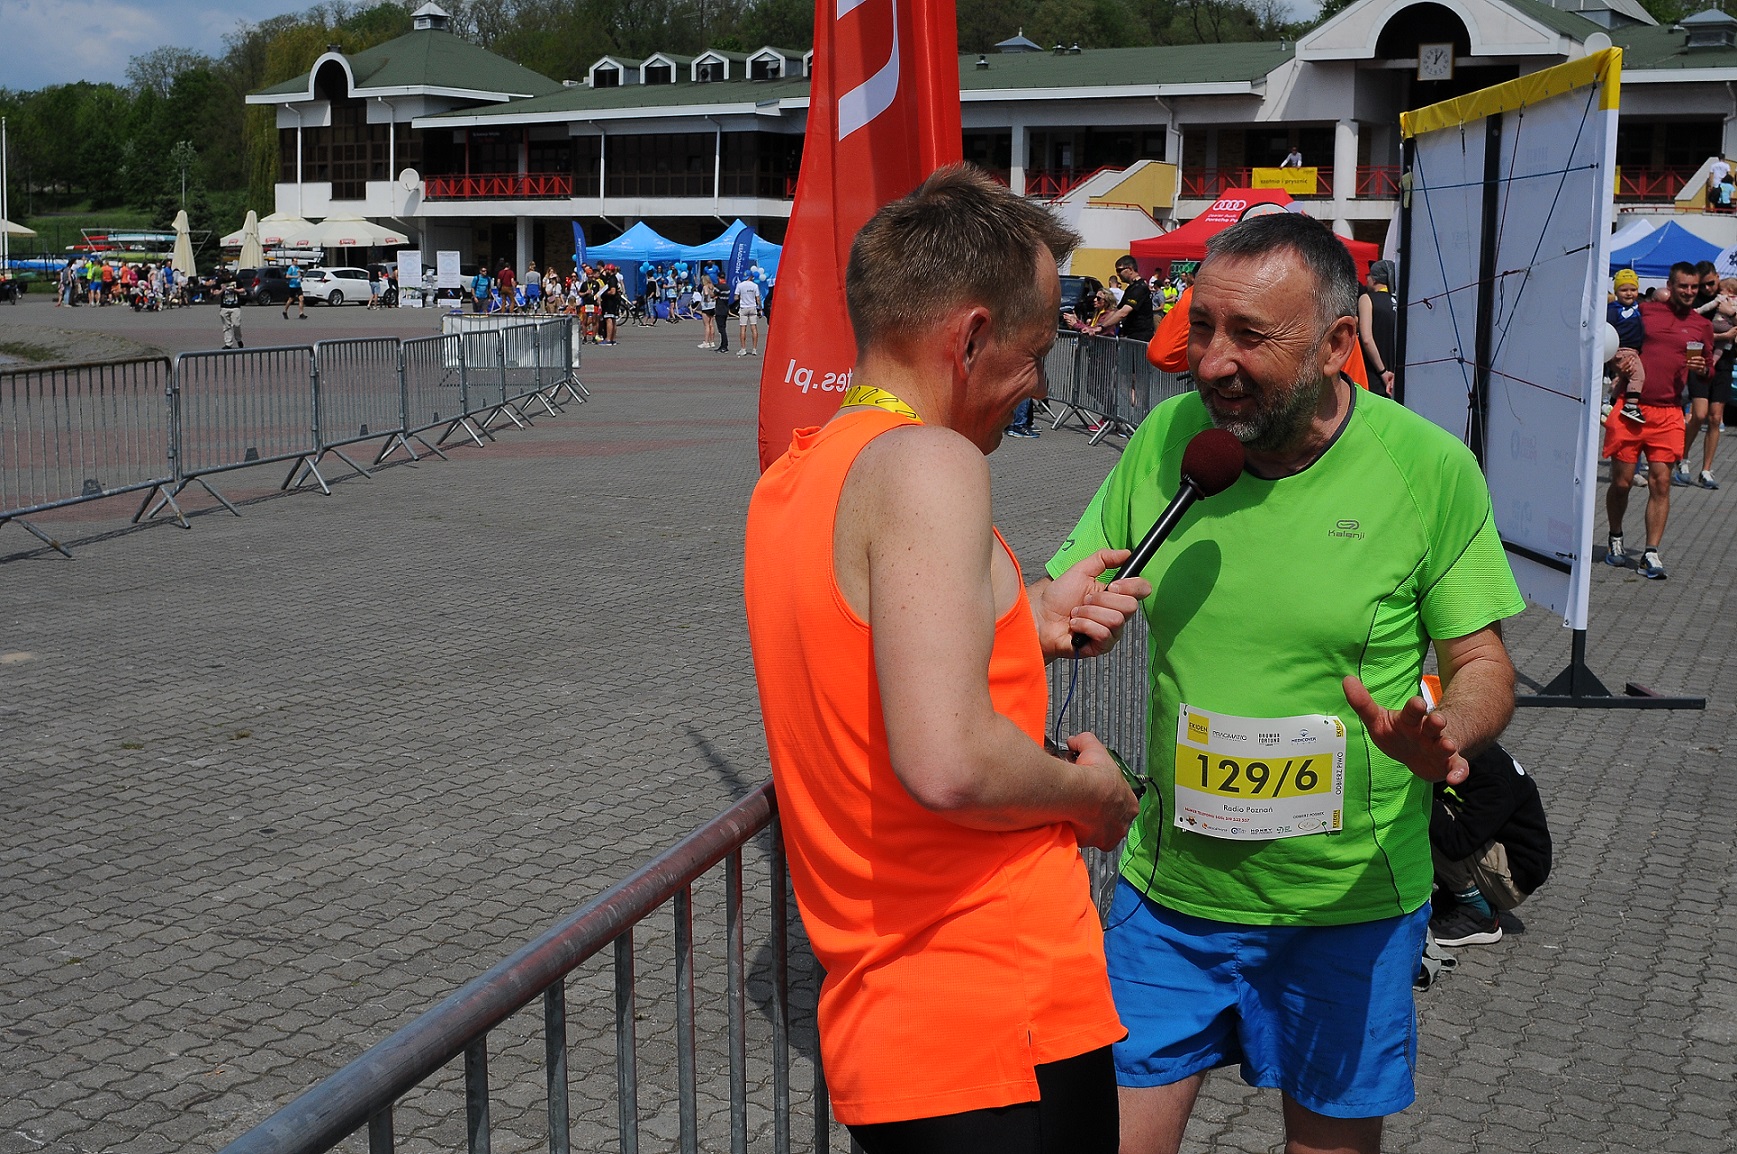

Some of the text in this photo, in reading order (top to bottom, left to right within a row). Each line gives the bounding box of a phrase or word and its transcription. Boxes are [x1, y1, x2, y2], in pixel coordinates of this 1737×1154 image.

[1328, 529, 1365, 541] Kalenji
[1197, 753, 1319, 798] 129/6
[1335, 751, 1344, 795] ODBIERZ PIWO
[1223, 804, 1273, 814] Radio Poznań
